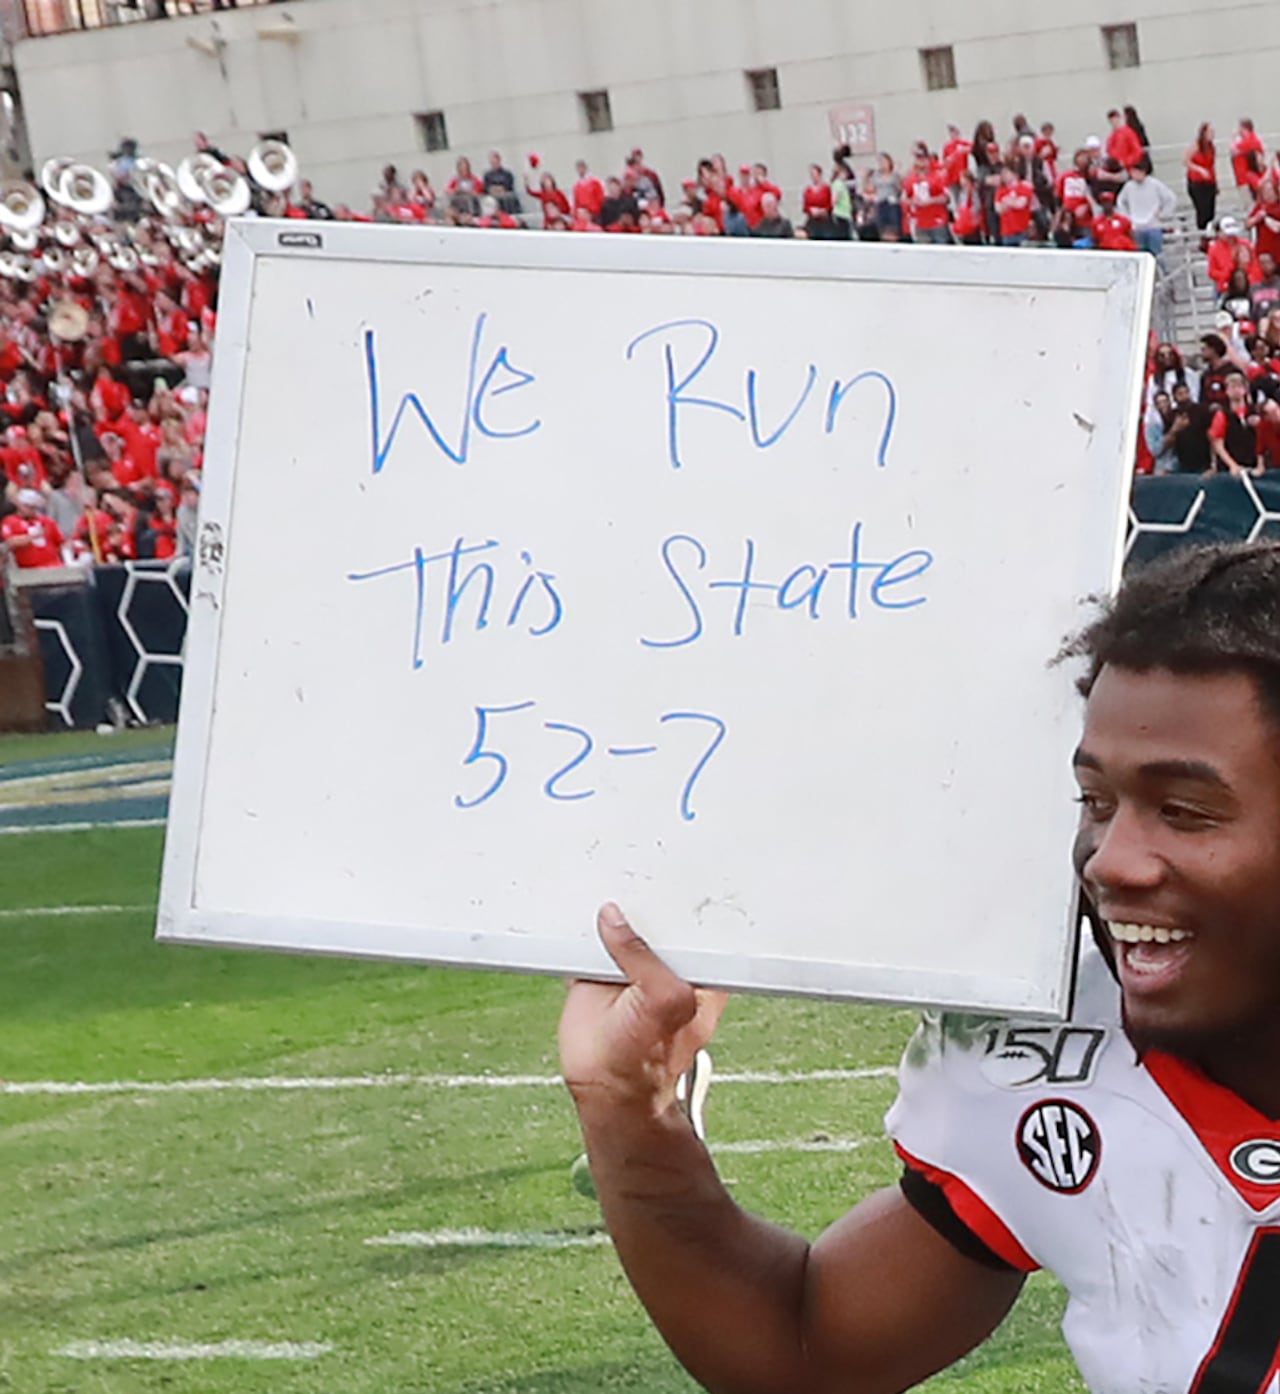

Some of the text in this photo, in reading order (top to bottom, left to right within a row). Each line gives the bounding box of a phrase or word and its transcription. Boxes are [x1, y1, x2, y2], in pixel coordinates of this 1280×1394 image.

[364, 312, 897, 475] We Run
[347, 521, 933, 670] This State
[454, 700, 726, 821] 52-7
[1021, 1103, 1094, 1189] SEC
